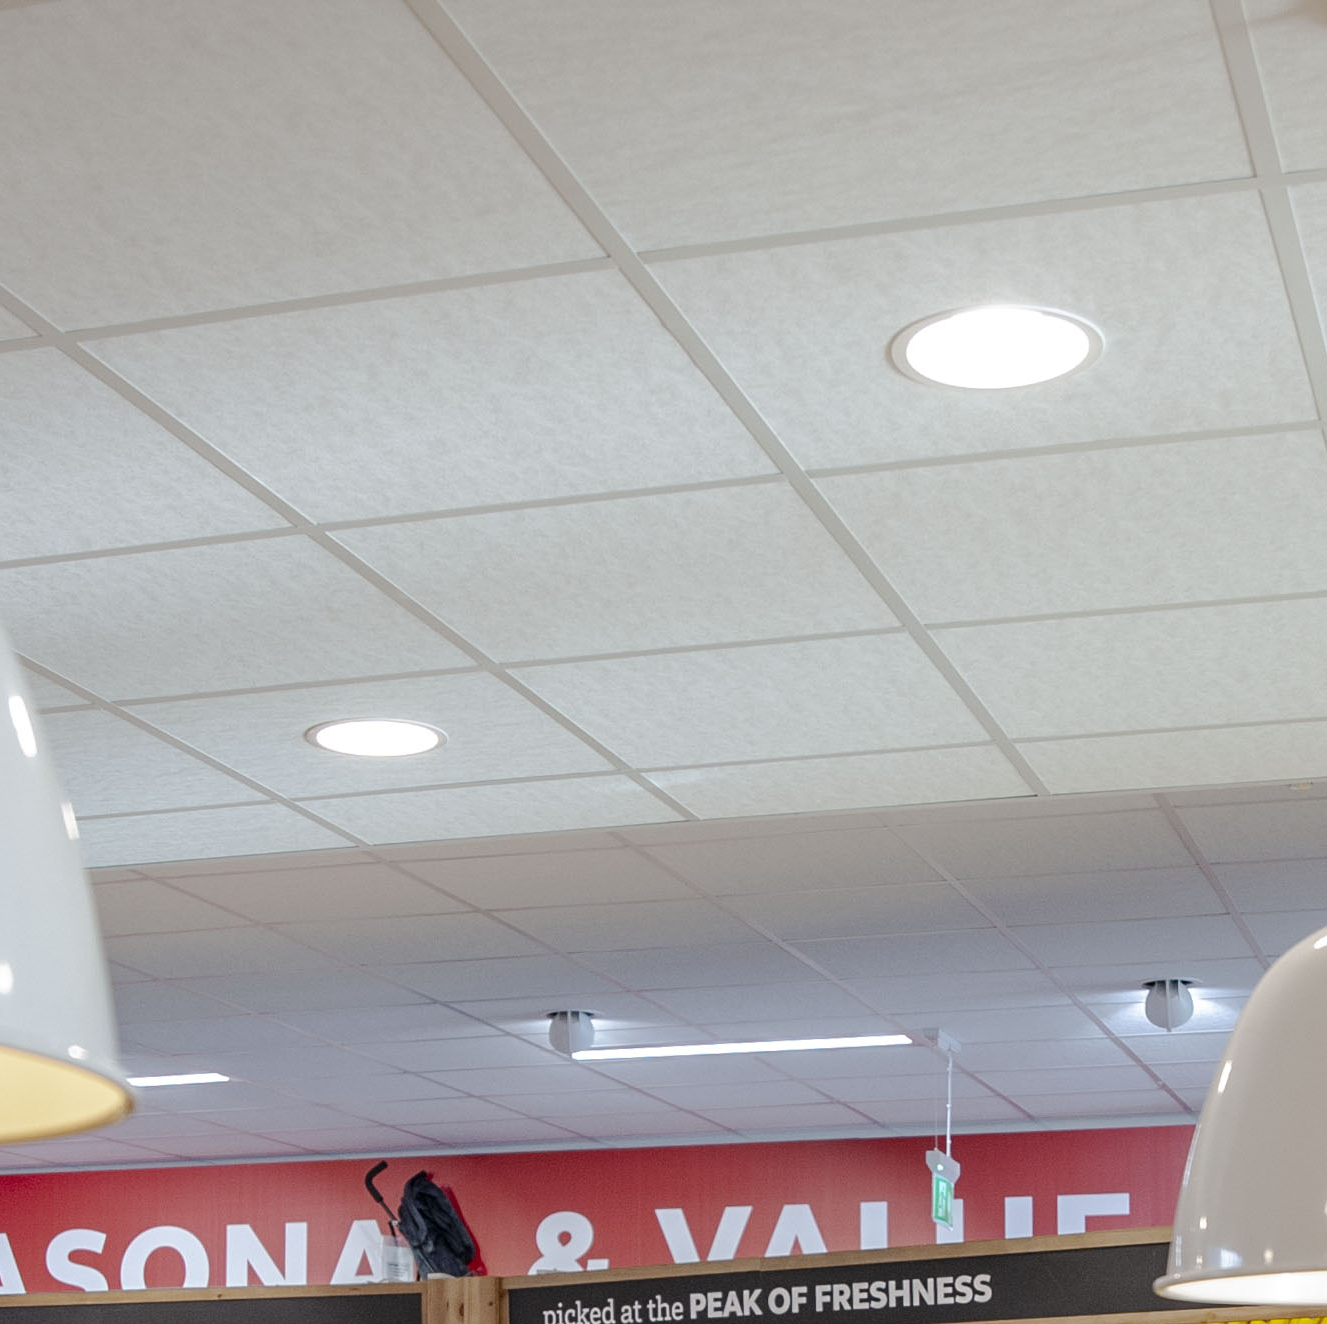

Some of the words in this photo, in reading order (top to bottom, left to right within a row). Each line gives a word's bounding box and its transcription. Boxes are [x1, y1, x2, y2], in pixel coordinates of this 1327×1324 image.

[621, 1300, 643, 1324] at
[647, 1296, 684, 1323] the
[689, 1286, 763, 1320] PEAK
[767, 1284, 807, 1315] OF
[815, 1273, 993, 1311] FRESHNESS
